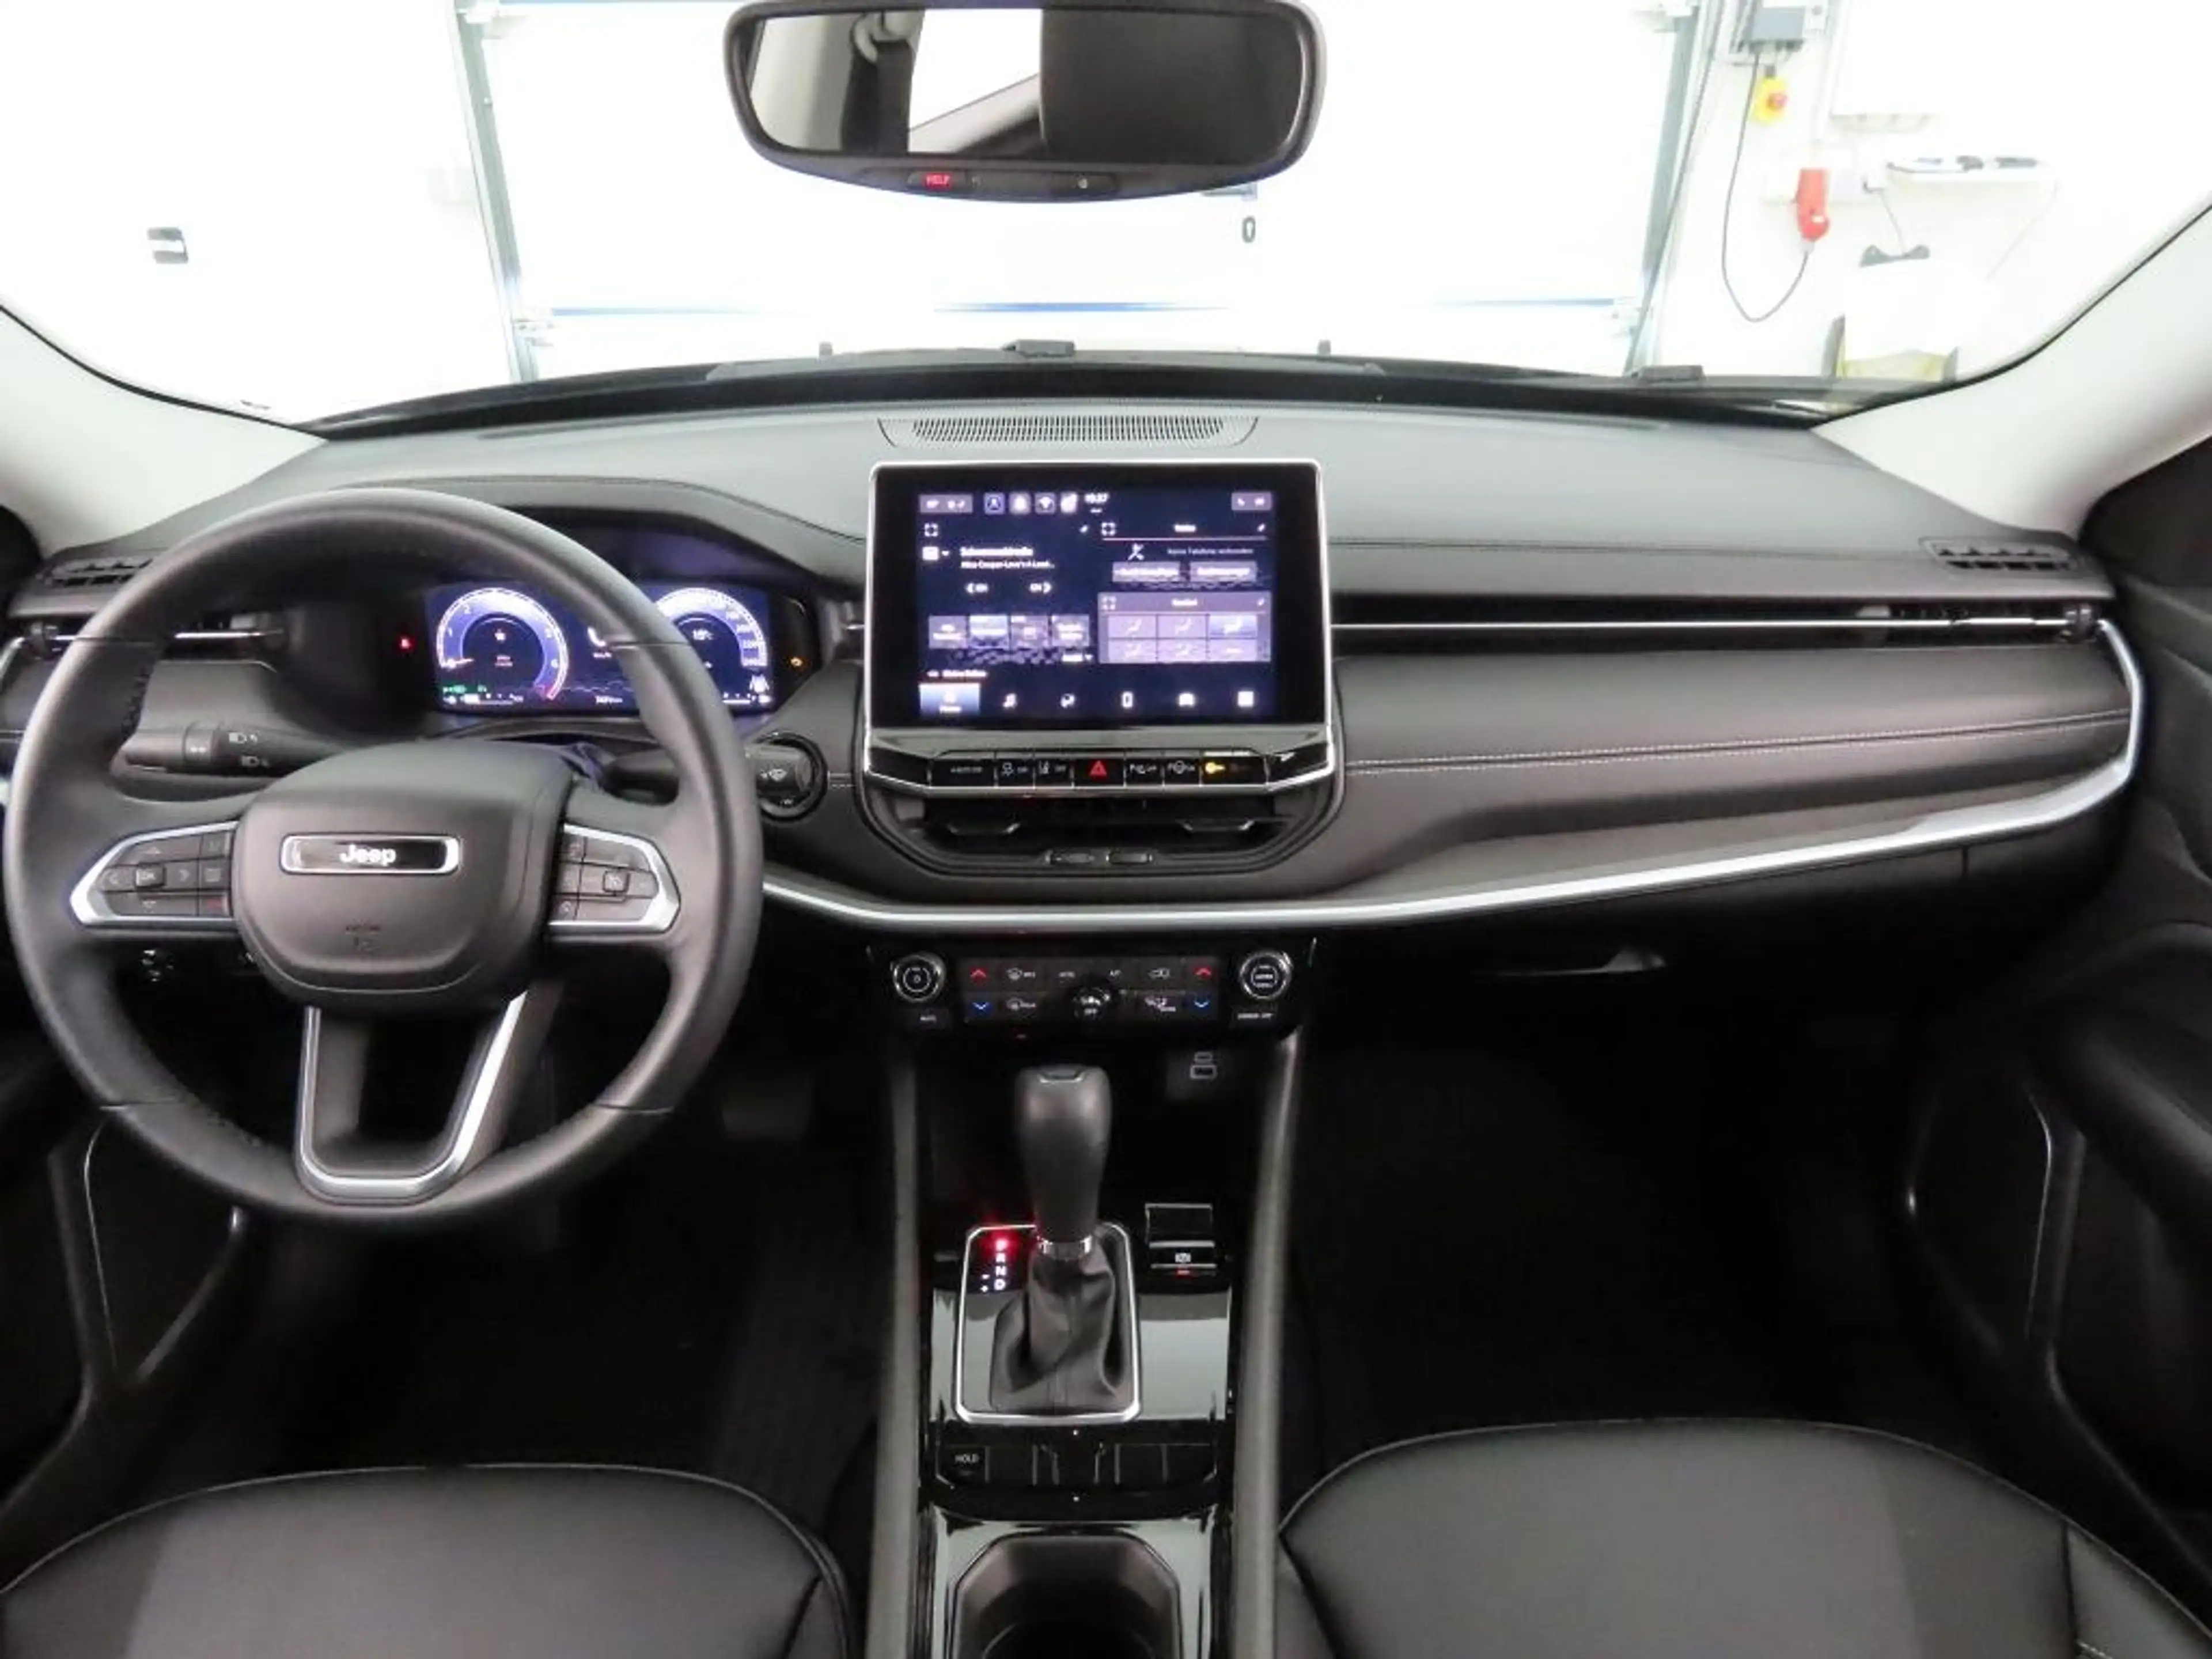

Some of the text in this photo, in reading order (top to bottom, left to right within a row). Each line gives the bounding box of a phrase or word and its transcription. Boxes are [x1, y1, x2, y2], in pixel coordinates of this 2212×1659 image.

[925, 175, 950, 185] HELP
[339, 843, 397, 867] Jeep
[995, 1266, 1007, 1276] N
[994, 1279, 1006, 1291] D
